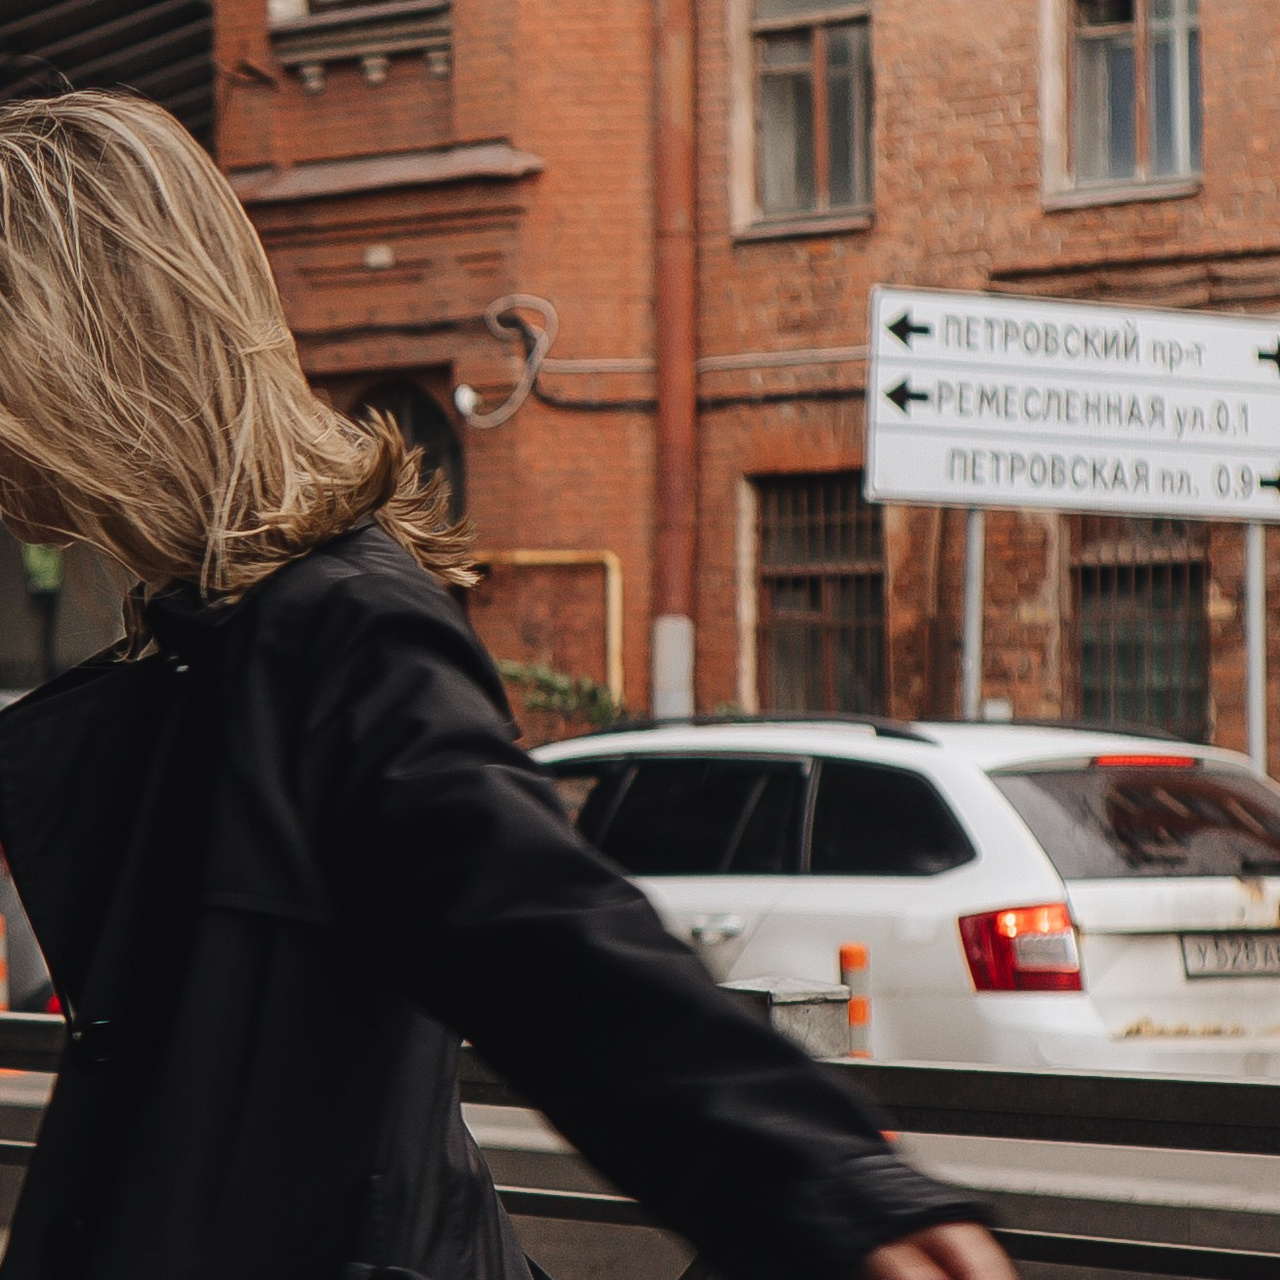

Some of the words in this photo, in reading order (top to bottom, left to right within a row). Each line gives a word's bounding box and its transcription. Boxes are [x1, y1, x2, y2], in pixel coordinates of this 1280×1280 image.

[943, 314, 1140, 362] ПЕТРОВСКИЙ
[1152, 338, 1205, 373] пр-т
[936, 380, 1165, 429] РЕМЕСЛЕННАЯ
[948, 448, 1150, 493] ПЕТРОВСКАЯ
[1160, 469, 1199, 497] пл.
[1217, 463, 1254, 499] 0,9
